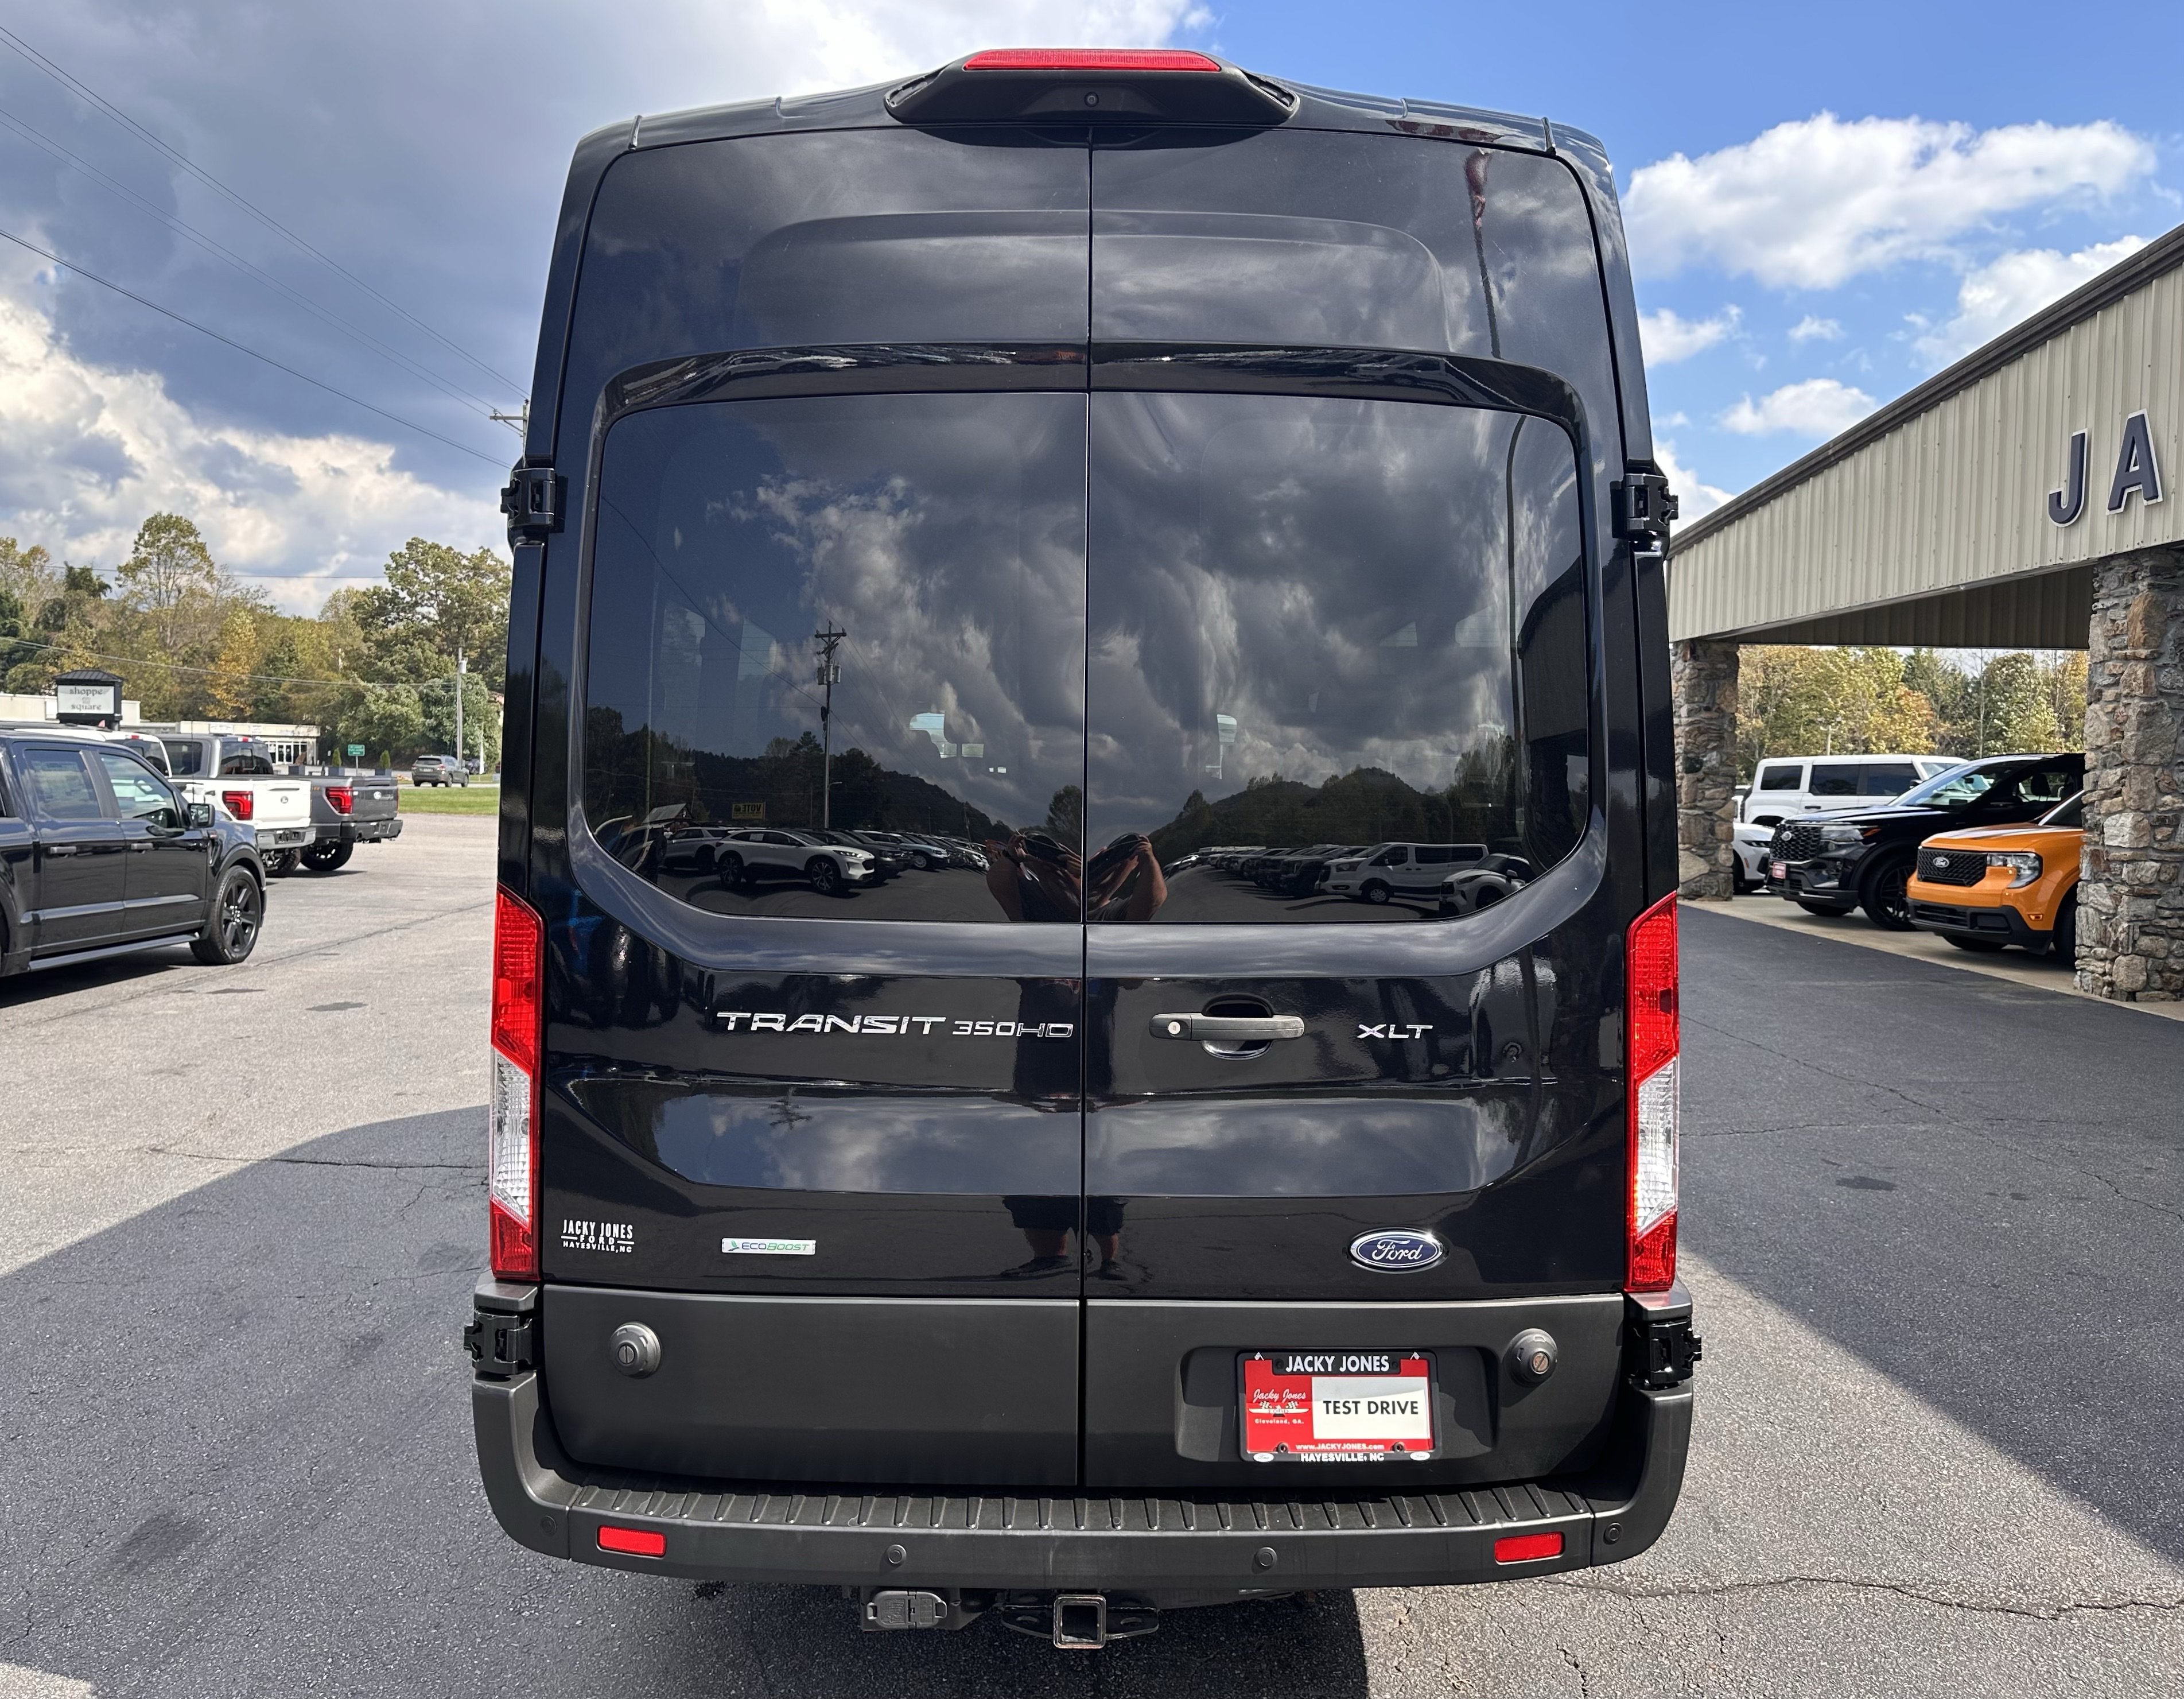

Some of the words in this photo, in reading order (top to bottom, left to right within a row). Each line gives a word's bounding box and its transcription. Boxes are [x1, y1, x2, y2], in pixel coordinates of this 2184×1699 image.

[69, 686, 104, 697] shoppe
[717, 1011, 946, 1035] TRANSIT
[953, 1021, 1073, 1038] 350HD
[1357, 1023, 1433, 1039] XLT
[562, 1219, 596, 1236] JACKY
[600, 1223, 633, 1239] JONES
[580, 1234, 615, 1245] FORD
[1371, 1239, 1424, 1260] Ford
[1285, 1355, 1335, 1372] JACKY
[1339, 1355, 1390, 1372] JONES
[1253, 1388, 1280, 1403] Jacky
[1282, 1388, 1307, 1403] Jones
[1323, 1400, 1361, 1415] TEST
[1367, 1400, 1419, 1415] DRIVE
[1295, 1442, 1385, 1450] www.JACKYJONES.com
[1300, 1452, 1367, 1462] HAYESVILLE,
[1369, 1453, 1385, 1461] NC
